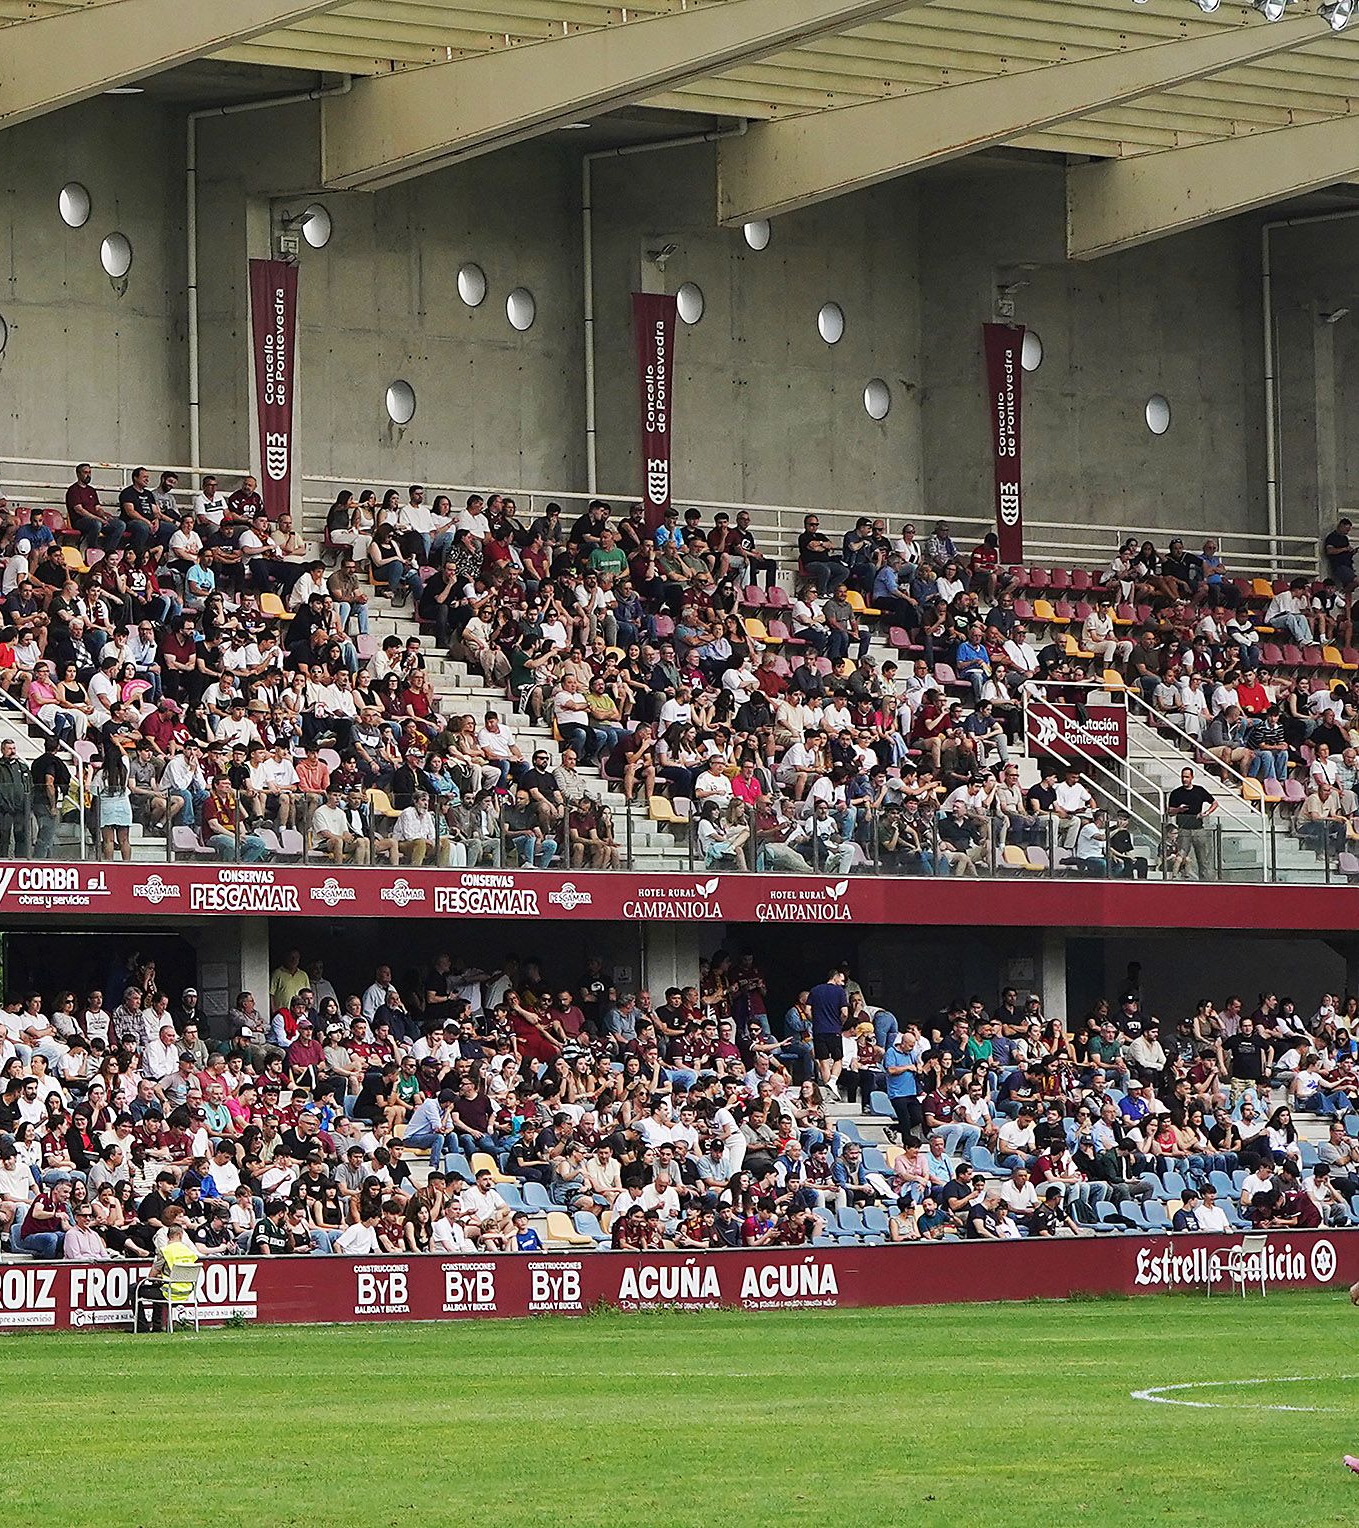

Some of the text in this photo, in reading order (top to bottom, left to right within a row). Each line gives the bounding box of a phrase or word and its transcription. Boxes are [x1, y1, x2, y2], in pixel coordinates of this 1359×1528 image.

[274, 288, 285, 406] de Pontevedra
[264, 334, 274, 405] Concello
[655, 321, 666, 433] de Pontevedra
[645, 365, 655, 432] Concello
[1005, 350, 1016, 457] de Pontevedra
[997, 392, 1006, 457] Concello
[18, 867, 79, 890] CORBA
[218, 870, 275, 884] CONSERVAS
[461, 874, 514, 887] CONSERVAS
[133, 884, 180, 897] PESCAMAR
[191, 884, 301, 911] PESCAMAR
[310, 887, 356, 900] PESCAMAR
[380, 888, 426, 900] PESCAMAR
[549, 891, 592, 904] PESCAMAR
[638, 889, 696, 897] HOTEL RURAL
[770, 890, 826, 900] HOTEL RURAL
[18, 895, 90, 908] obras y servicios
[434, 887, 540, 915] PESCAMAR
[623, 901, 723, 919] CAMPANIOLA
[755, 903, 852, 921] CAMPANIOLA
[353, 1264, 409, 1273] CONSTRUCCIONES
[441, 1263, 496, 1272] CONSTRUCCIONES
[527, 1262, 582, 1271] CONSTRUCCIONES
[1134, 1243, 1307, 1285] Estrella Galicia
[192, 1264, 258, 1303] ROIZ
[618, 1257, 721, 1299] ACUÑA
[740, 1255, 839, 1298] ACUÑA
